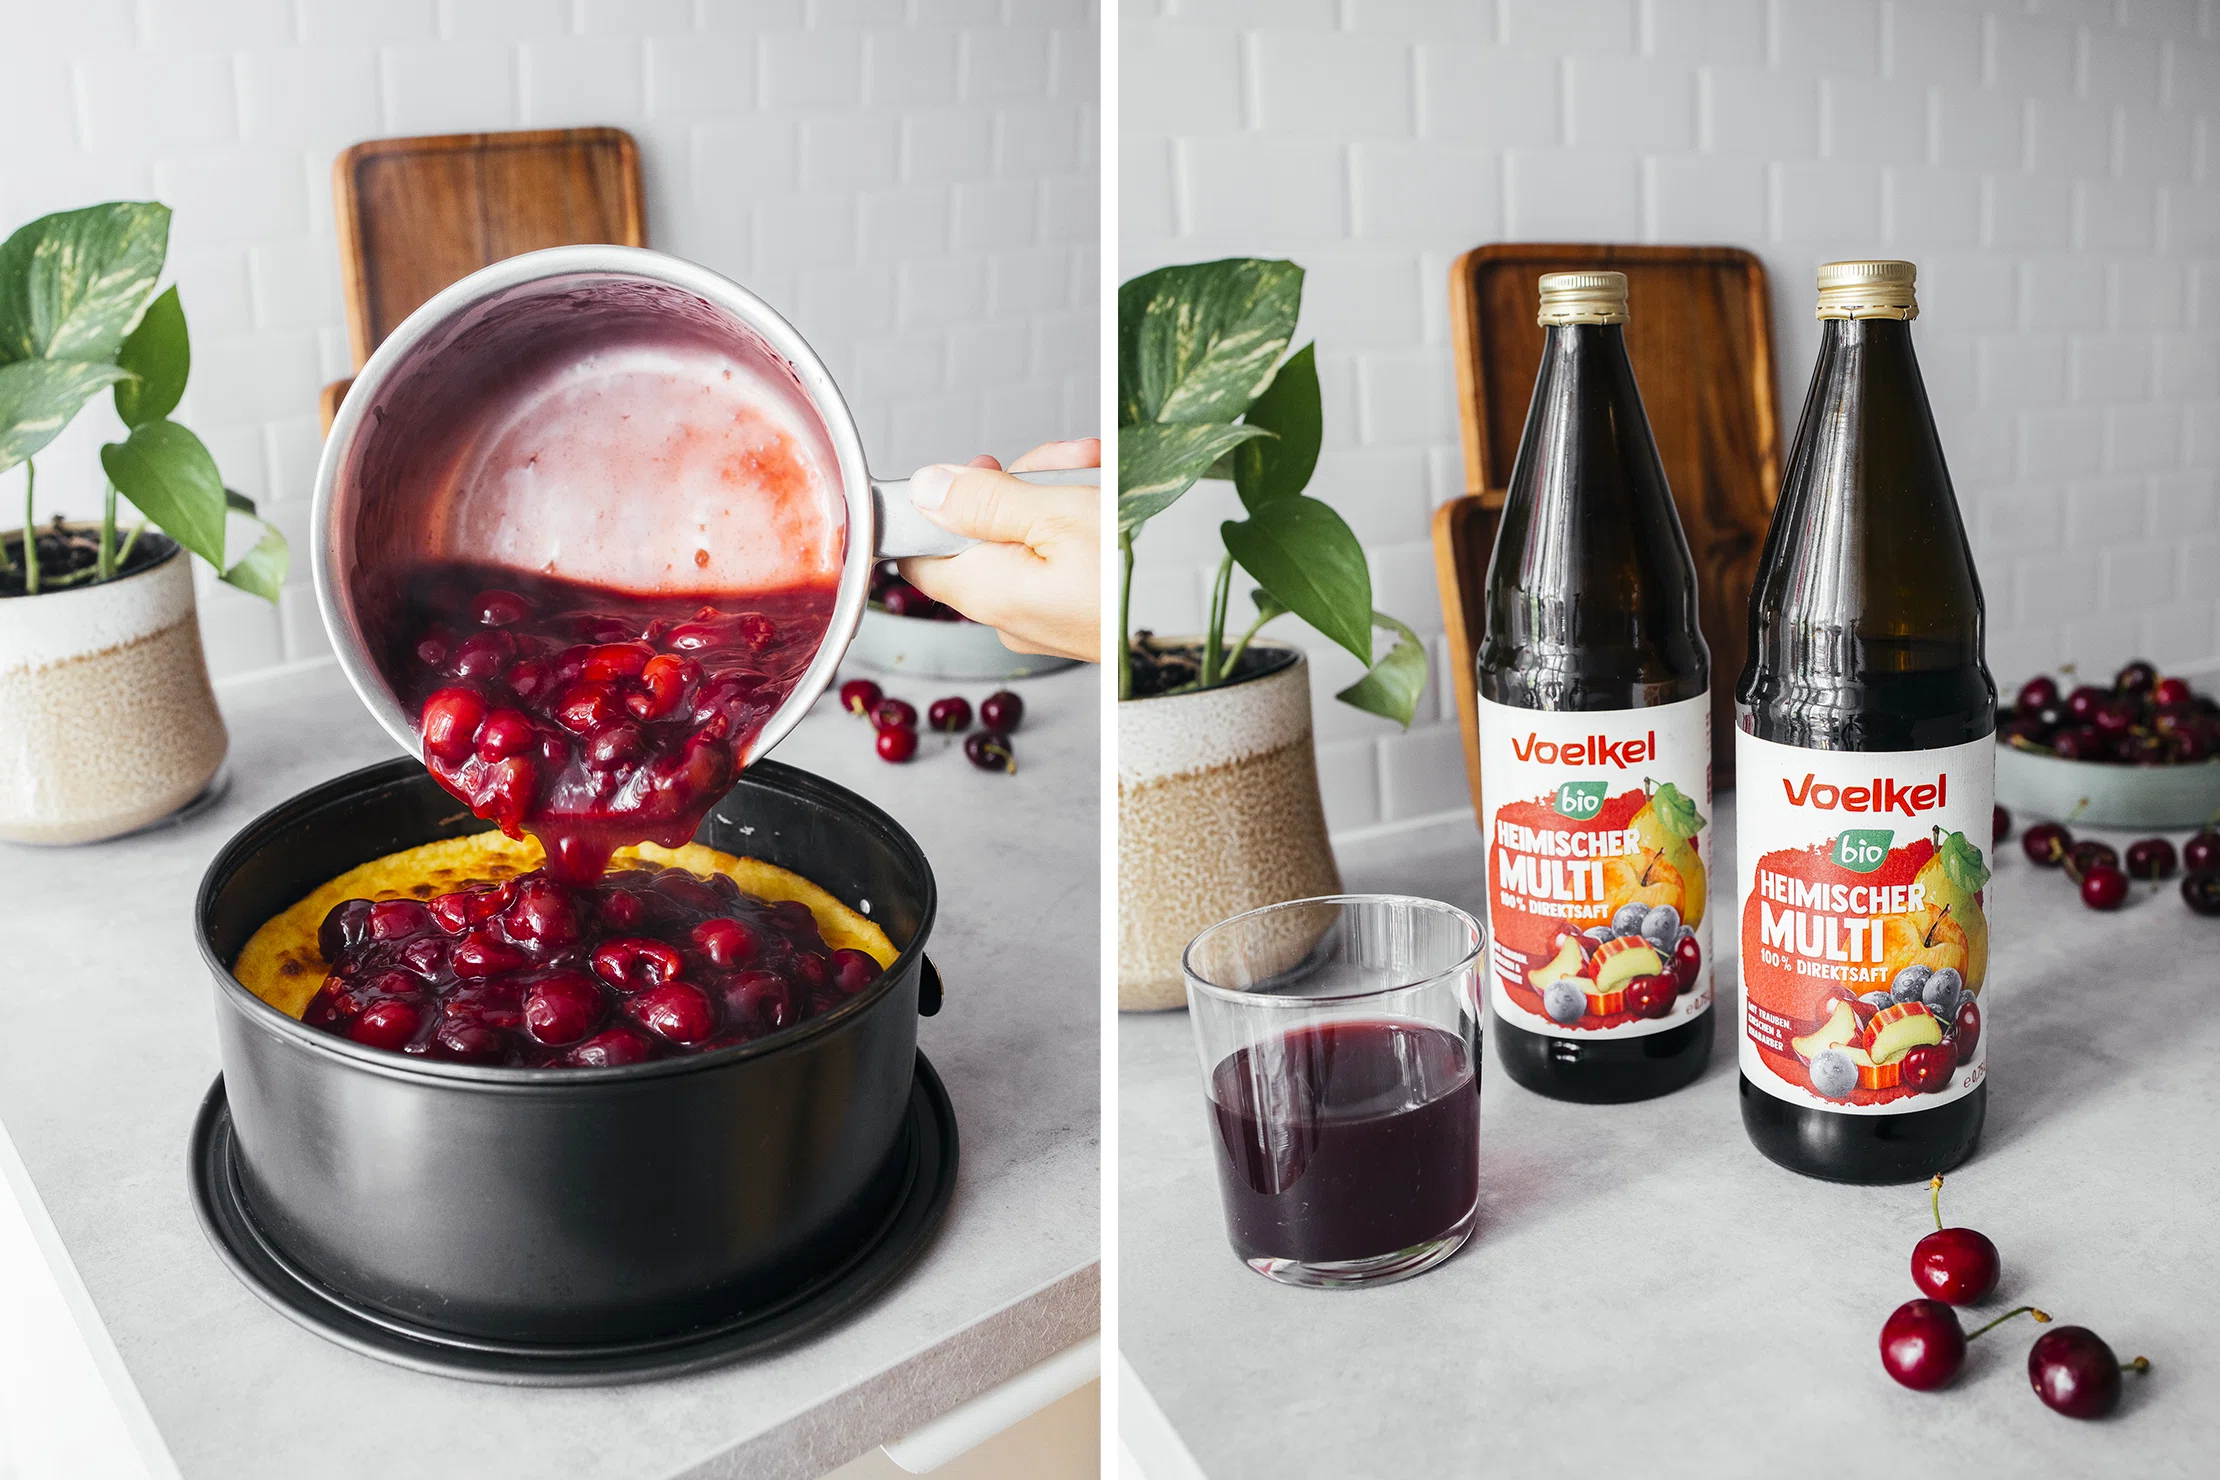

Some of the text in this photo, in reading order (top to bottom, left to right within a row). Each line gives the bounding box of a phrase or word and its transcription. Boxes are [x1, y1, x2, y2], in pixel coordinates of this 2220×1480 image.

[1512, 730, 1655, 769] Voelkel
[1561, 785, 1598, 812] bio
[1782, 773, 1947, 817] Voelkel
[1497, 819, 1642, 858] HEIMISCHER
[1841, 835, 1883, 864] bio
[1498, 847, 1605, 901] MULTI
[1760, 869, 1926, 914] HEIMISCHER
[1528, 899, 1609, 919] DIREKTSAFT
[1760, 900, 1884, 963] MULTI
[1760, 948, 1780, 969] 100
[1797, 960, 1888, 983] DIREKTSAFT
